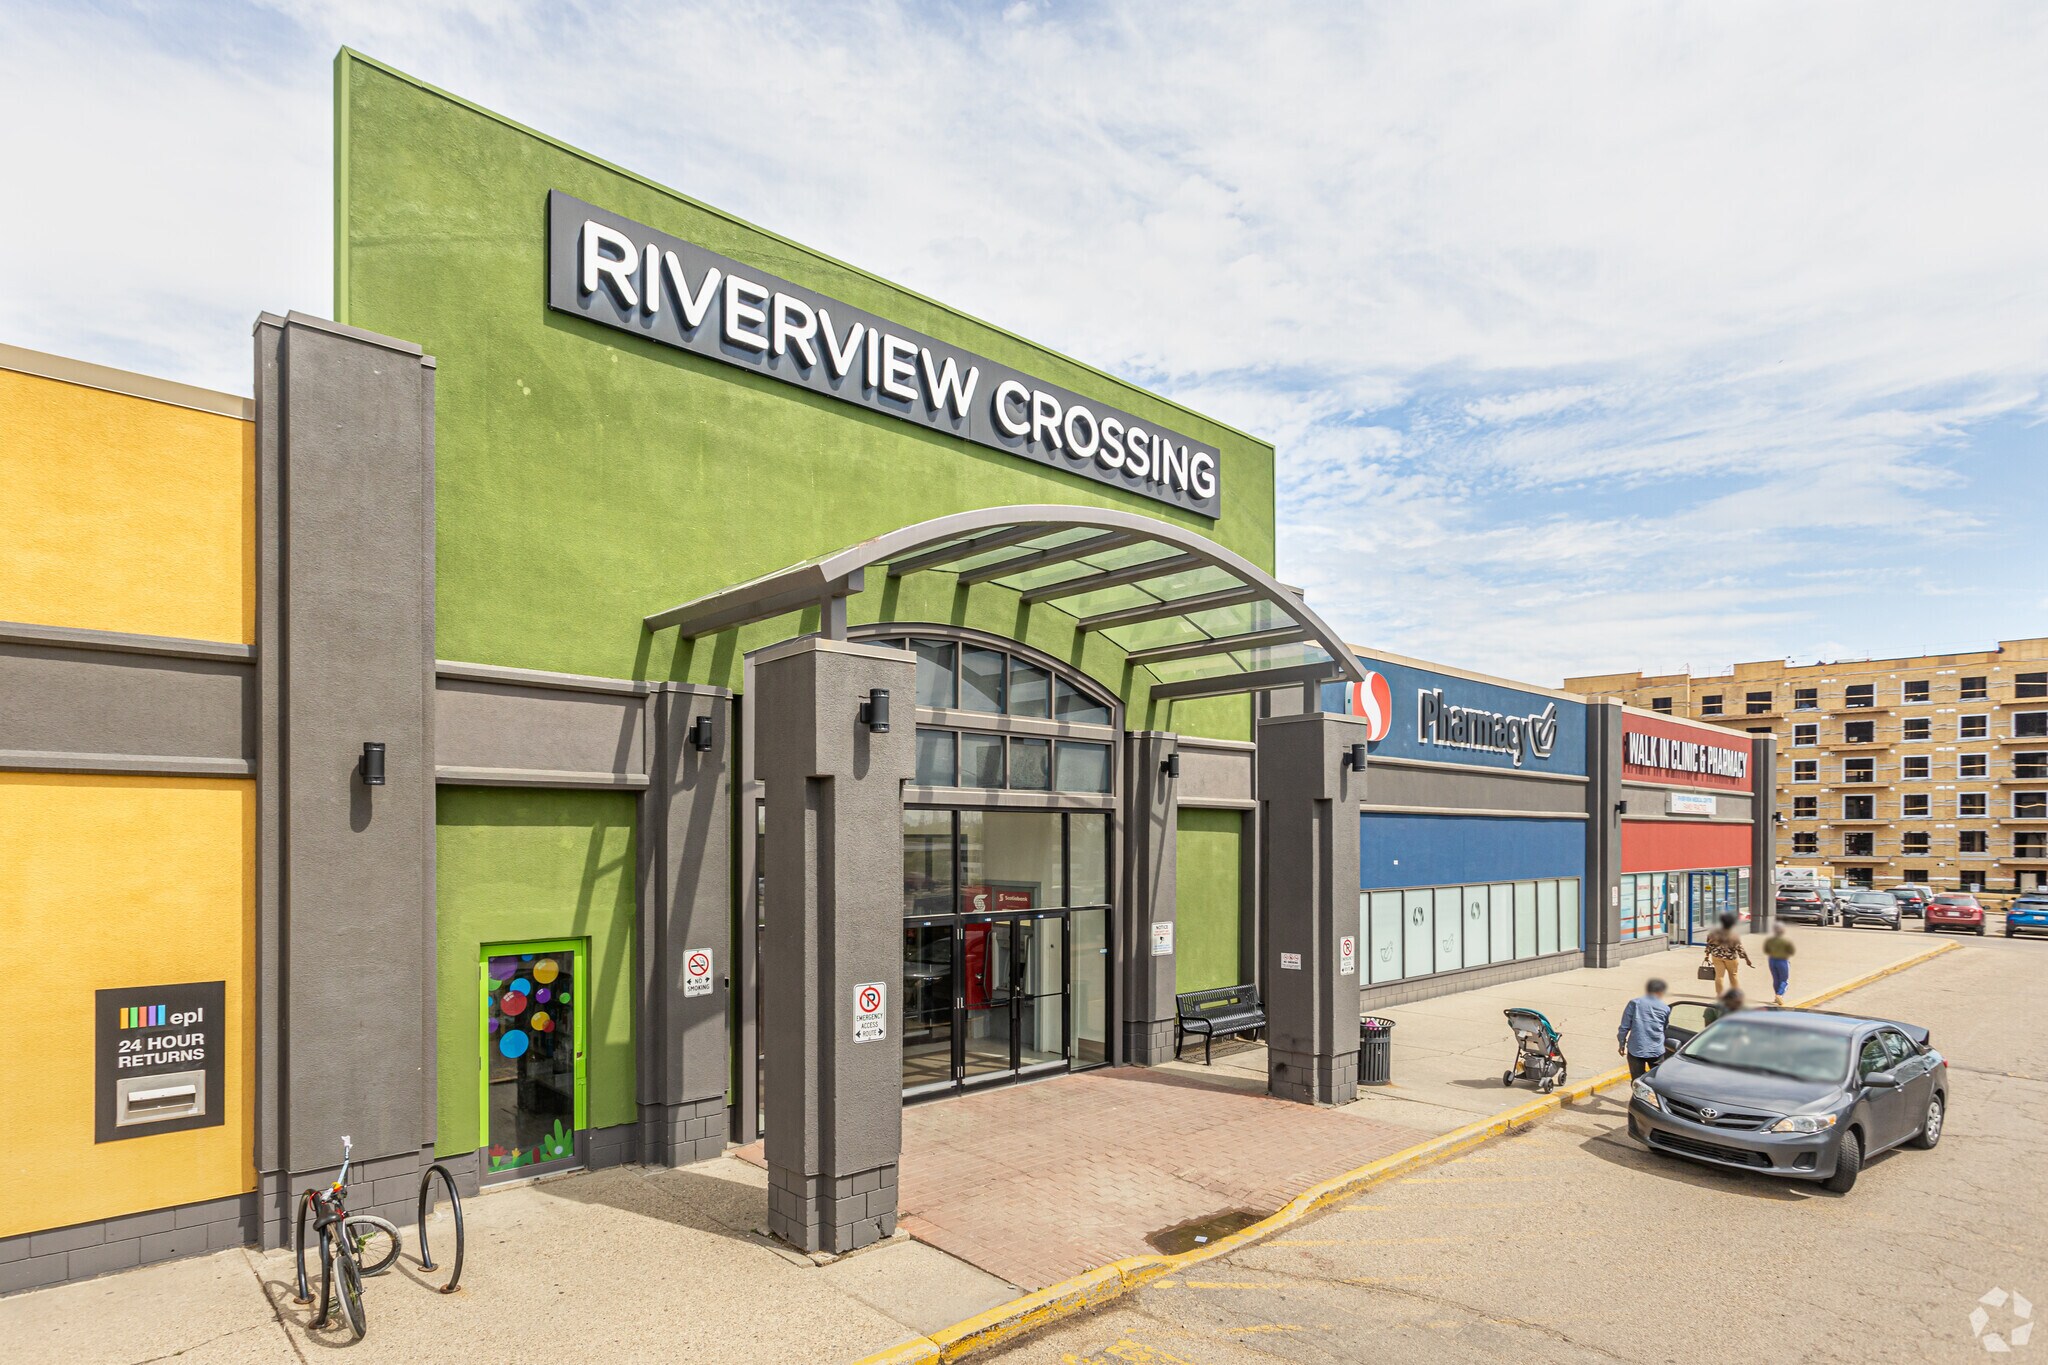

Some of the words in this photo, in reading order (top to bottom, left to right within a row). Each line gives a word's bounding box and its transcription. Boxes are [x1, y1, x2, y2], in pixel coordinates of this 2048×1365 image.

[583, 219, 979, 418] RIVERVIEW
[996, 380, 1216, 499] CROSSING
[1418, 688, 1529, 767] Pharmacy
[1628, 731, 1658, 768] WALK
[1659, 737, 1670, 769] IN
[1671, 739, 1698, 772] CLINIC
[1699, 744, 1706, 773] &
[1707, 746, 1748, 778] PHARMACY
[687, 984, 710, 992] SMOKING
[170, 1007, 204, 1027] epl
[856, 1012, 883, 1022] EMERGENCY
[860, 1021, 879, 1029] ACCESS
[118, 1038, 142, 1053] 24
[147, 1032, 205, 1051] HOUR
[862, 1029, 877, 1037] ROUTE
[118, 1049, 205, 1069] RETURNS
